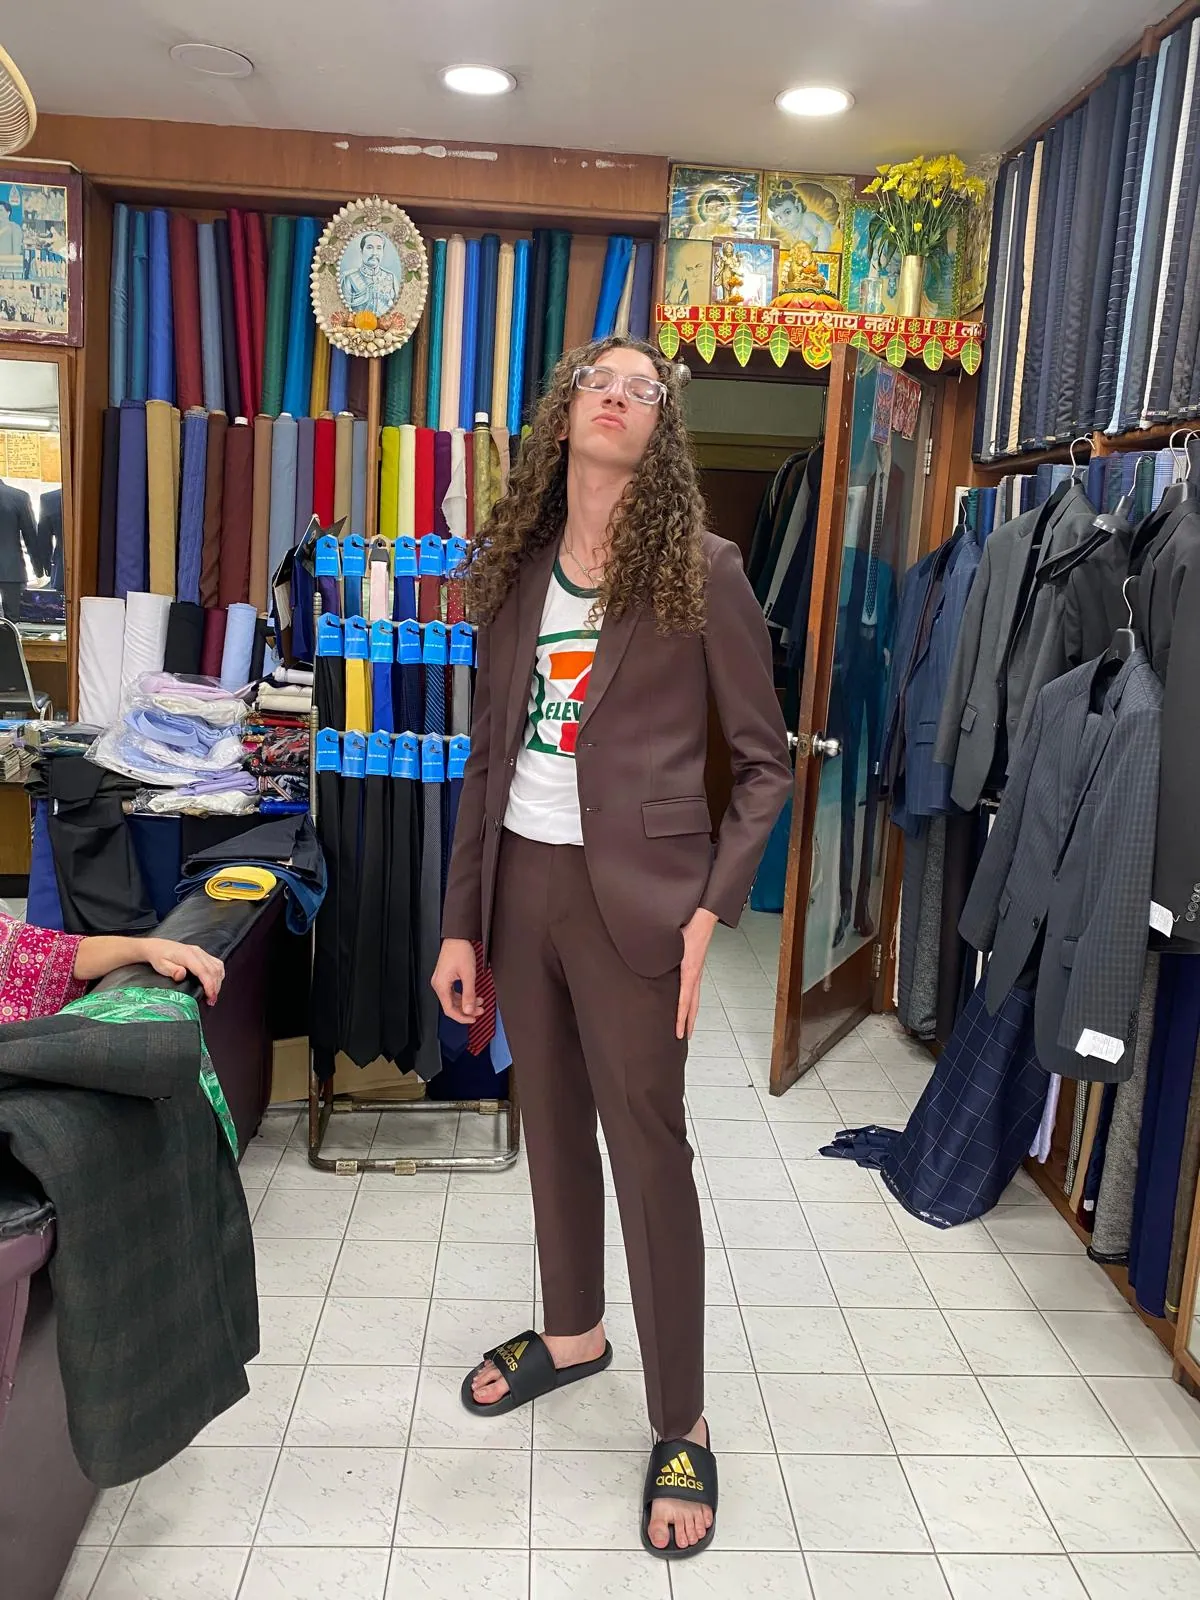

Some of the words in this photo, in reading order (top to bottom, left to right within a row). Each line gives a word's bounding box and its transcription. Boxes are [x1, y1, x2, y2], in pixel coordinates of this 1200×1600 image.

[663, 305, 691, 322] शुभ
[761, 308, 782, 324] श्री
[656, 1472, 704, 1491] adidas
